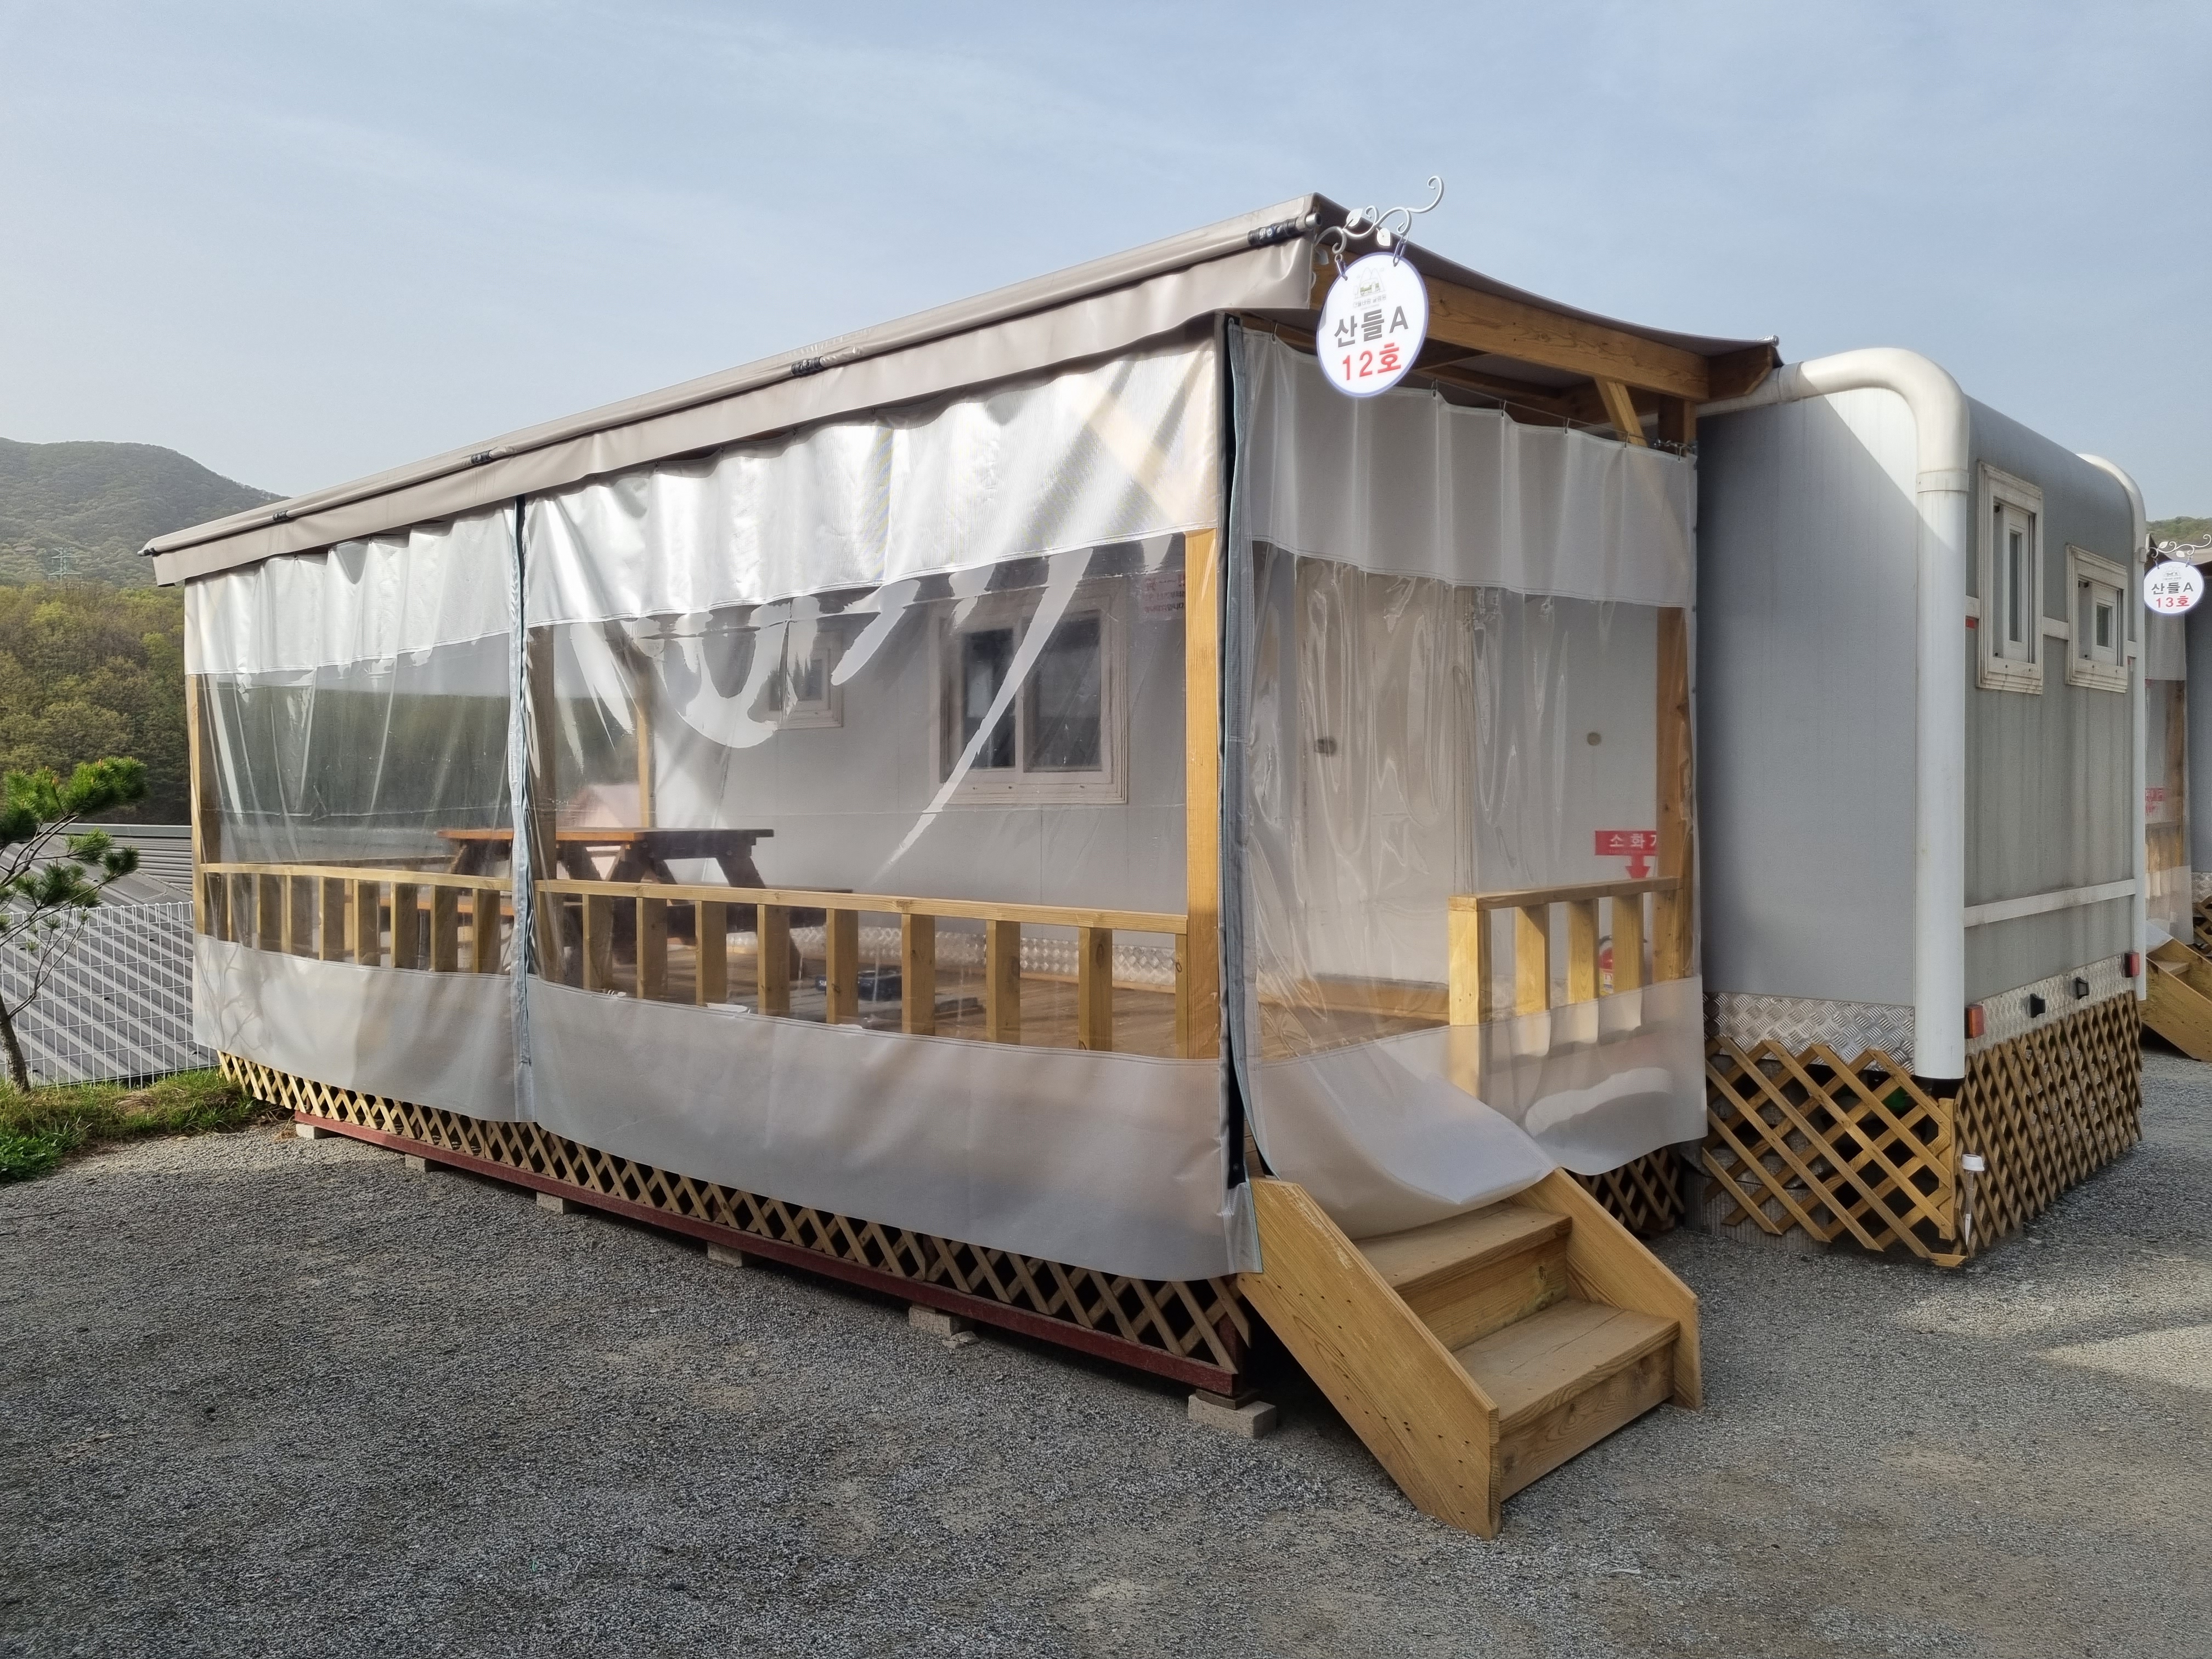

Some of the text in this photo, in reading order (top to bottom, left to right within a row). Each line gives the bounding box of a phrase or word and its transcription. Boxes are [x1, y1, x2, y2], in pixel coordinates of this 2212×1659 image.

[1334, 306, 1409, 348] 산들A
[1342, 343, 1401, 380] 12호
[2152, 582, 2193, 595] 산들A
[2156, 596, 2190, 608] 13호
